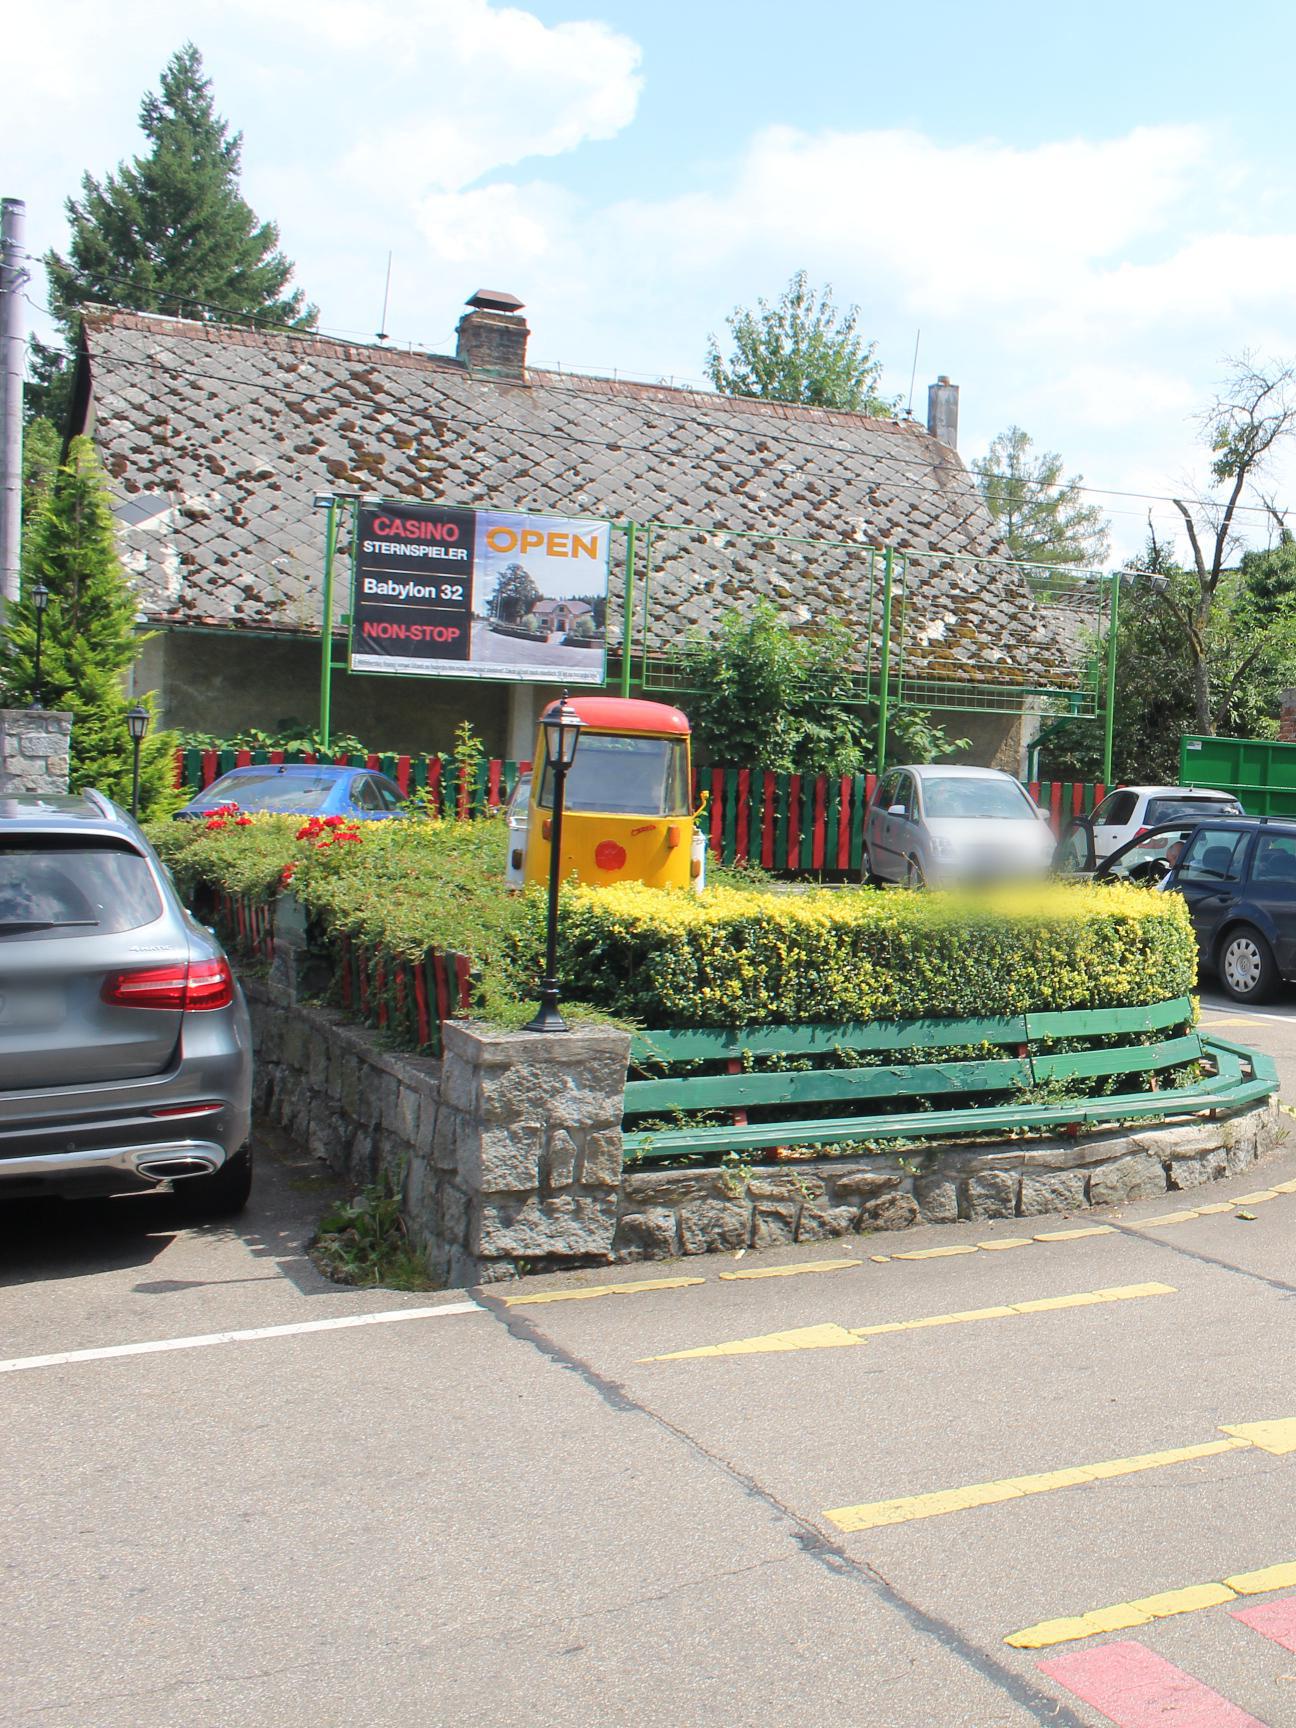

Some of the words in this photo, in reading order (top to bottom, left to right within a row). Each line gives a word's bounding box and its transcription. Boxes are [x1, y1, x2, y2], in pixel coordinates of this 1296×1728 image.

[373, 517, 459, 541] CASINO
[363, 540, 467, 560] STERNSPIELER
[486, 527, 598, 560] OPEN
[364, 578, 436, 599] Babylon
[441, 584, 463, 600] 32
[363, 622, 460, 642] NON-STOP
